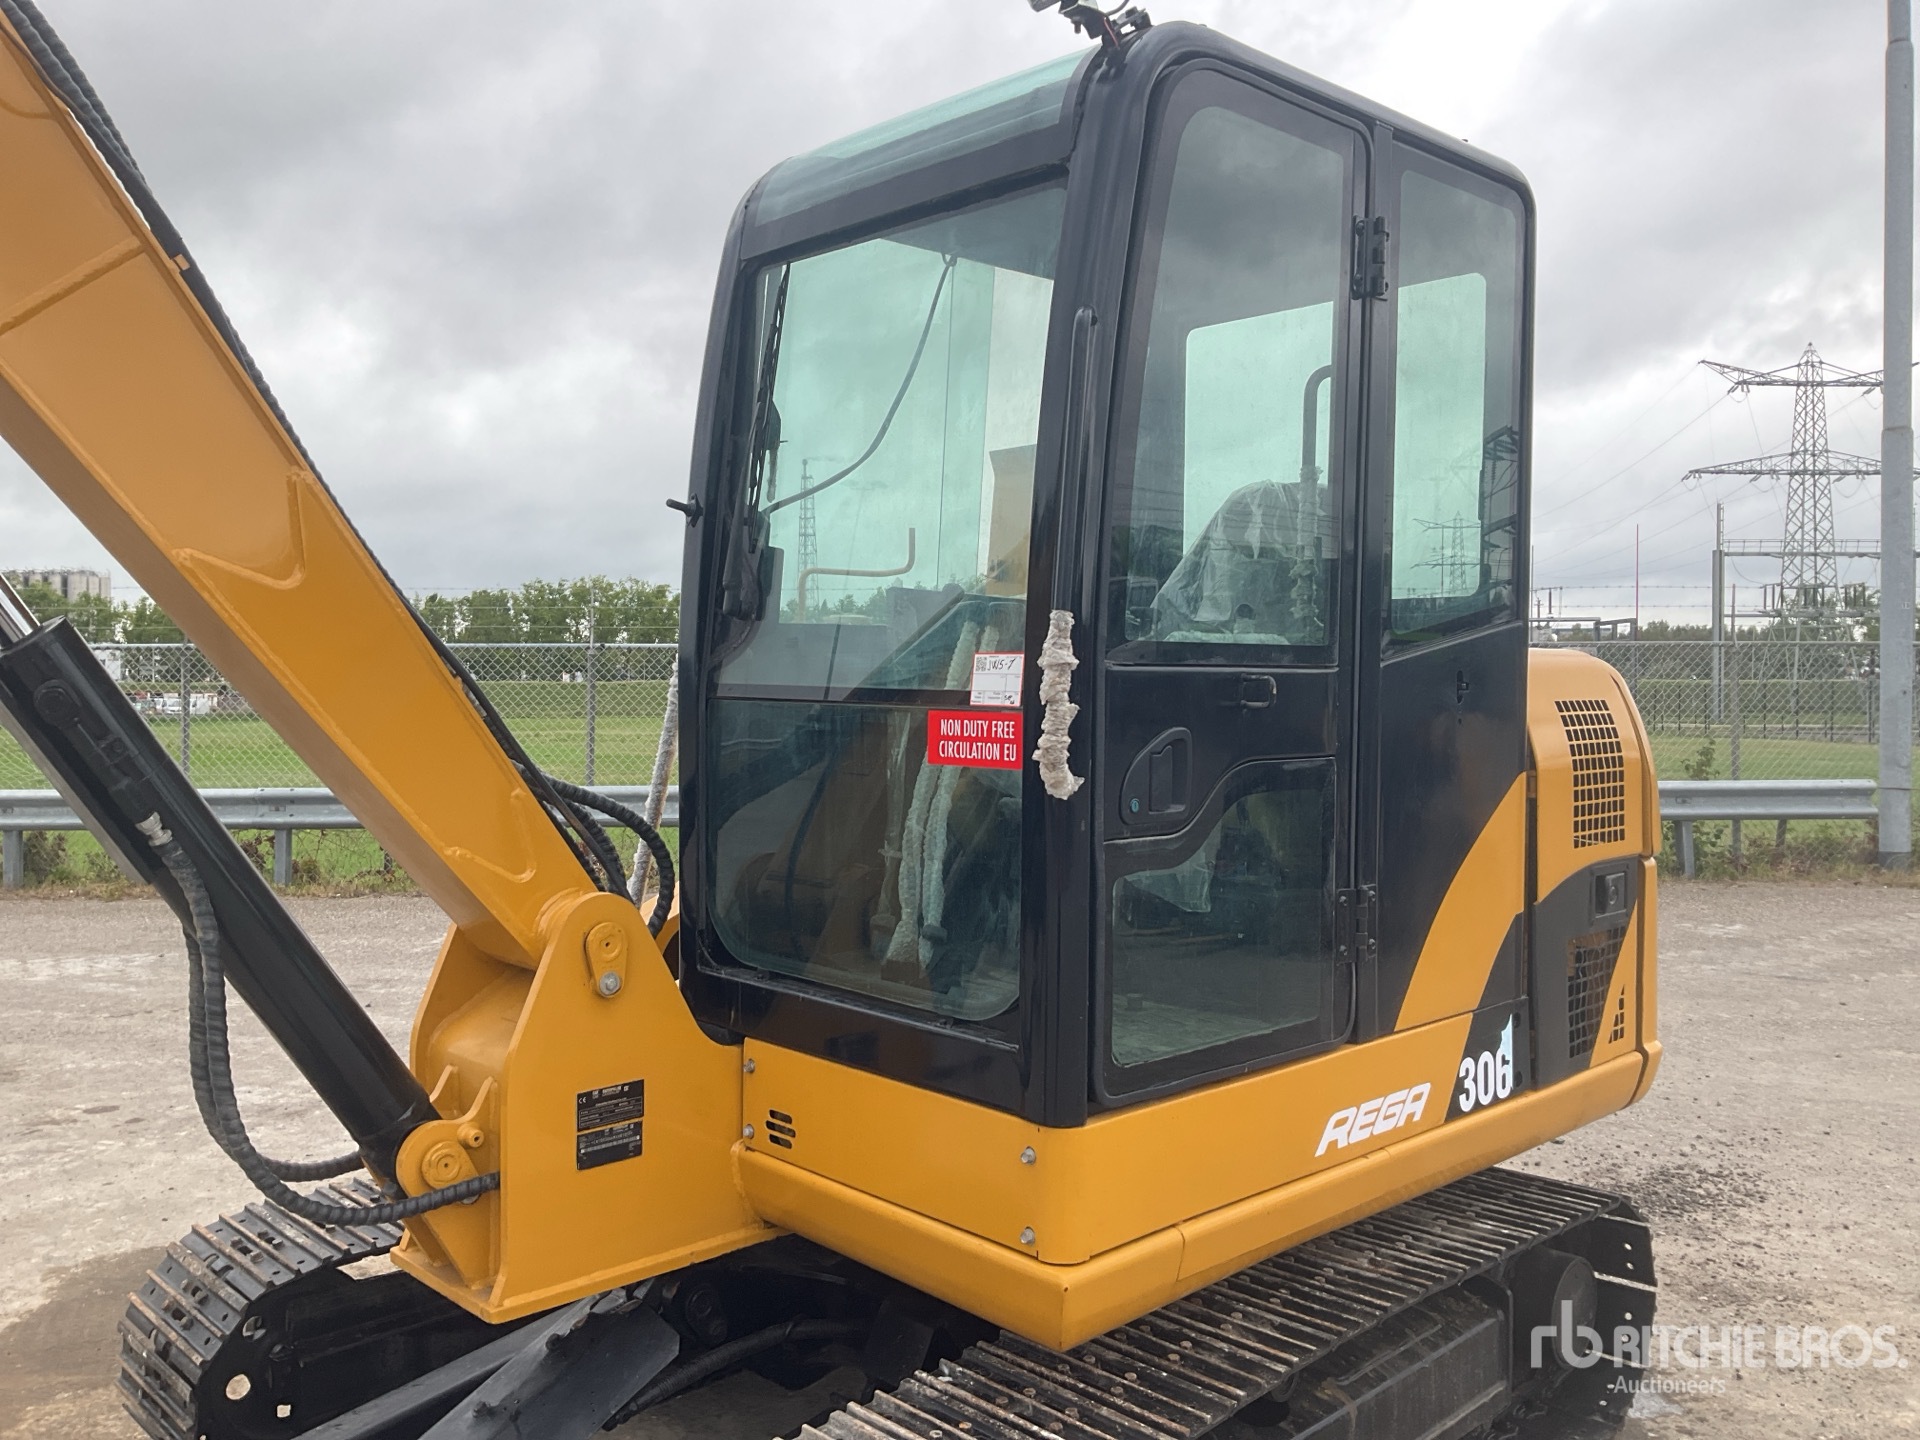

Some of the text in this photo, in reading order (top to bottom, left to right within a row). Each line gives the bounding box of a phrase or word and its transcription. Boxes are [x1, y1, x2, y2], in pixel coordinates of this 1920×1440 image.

[940, 719, 1015, 739] NON DUTY FREE
[939, 741, 1017, 761] CIRCULATION EU
[1458, 1050, 1511, 1112] 306
[1314, 1082, 1431, 1157] REGA
